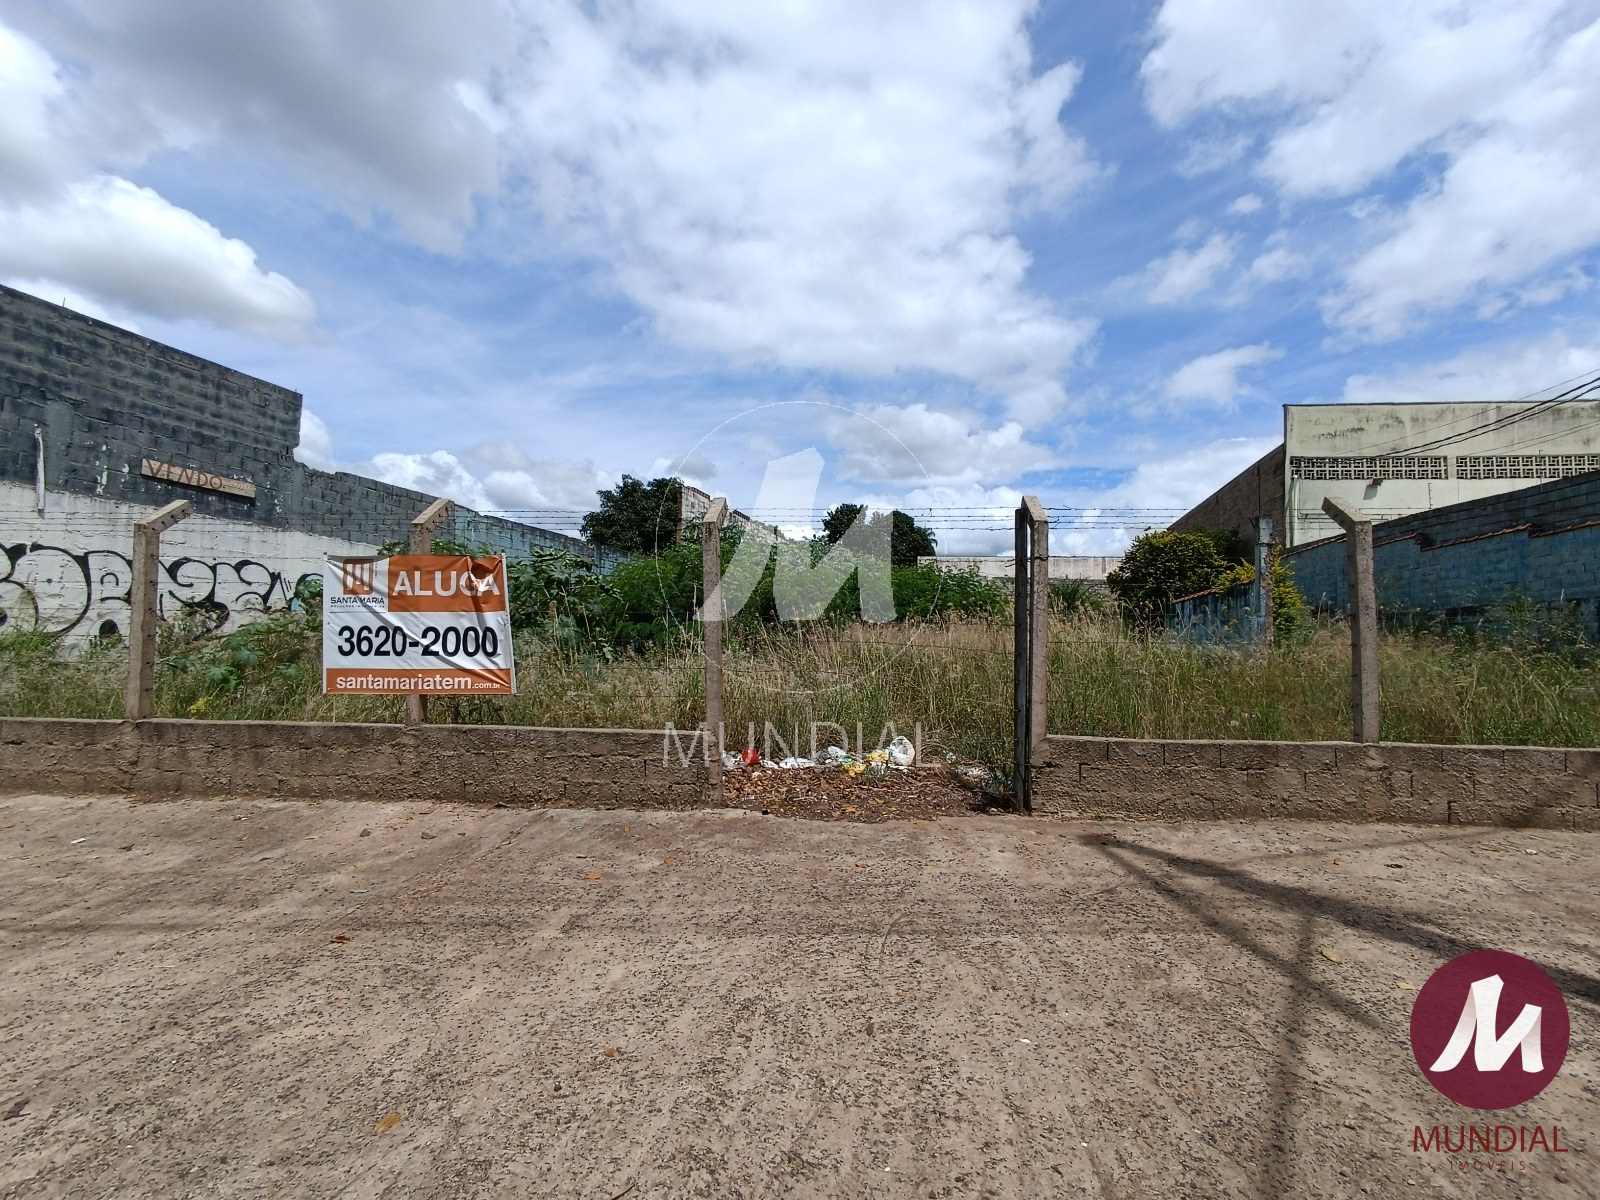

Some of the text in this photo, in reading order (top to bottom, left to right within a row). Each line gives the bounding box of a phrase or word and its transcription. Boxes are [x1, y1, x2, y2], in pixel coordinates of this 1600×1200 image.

[145, 459, 223, 490] VENDO
[392, 570, 501, 597] ALUGA
[330, 596, 385, 605] SANTA MARIA
[337, 625, 499, 658] 3620-2000
[336, 673, 501, 690] santamariatem.com.br
